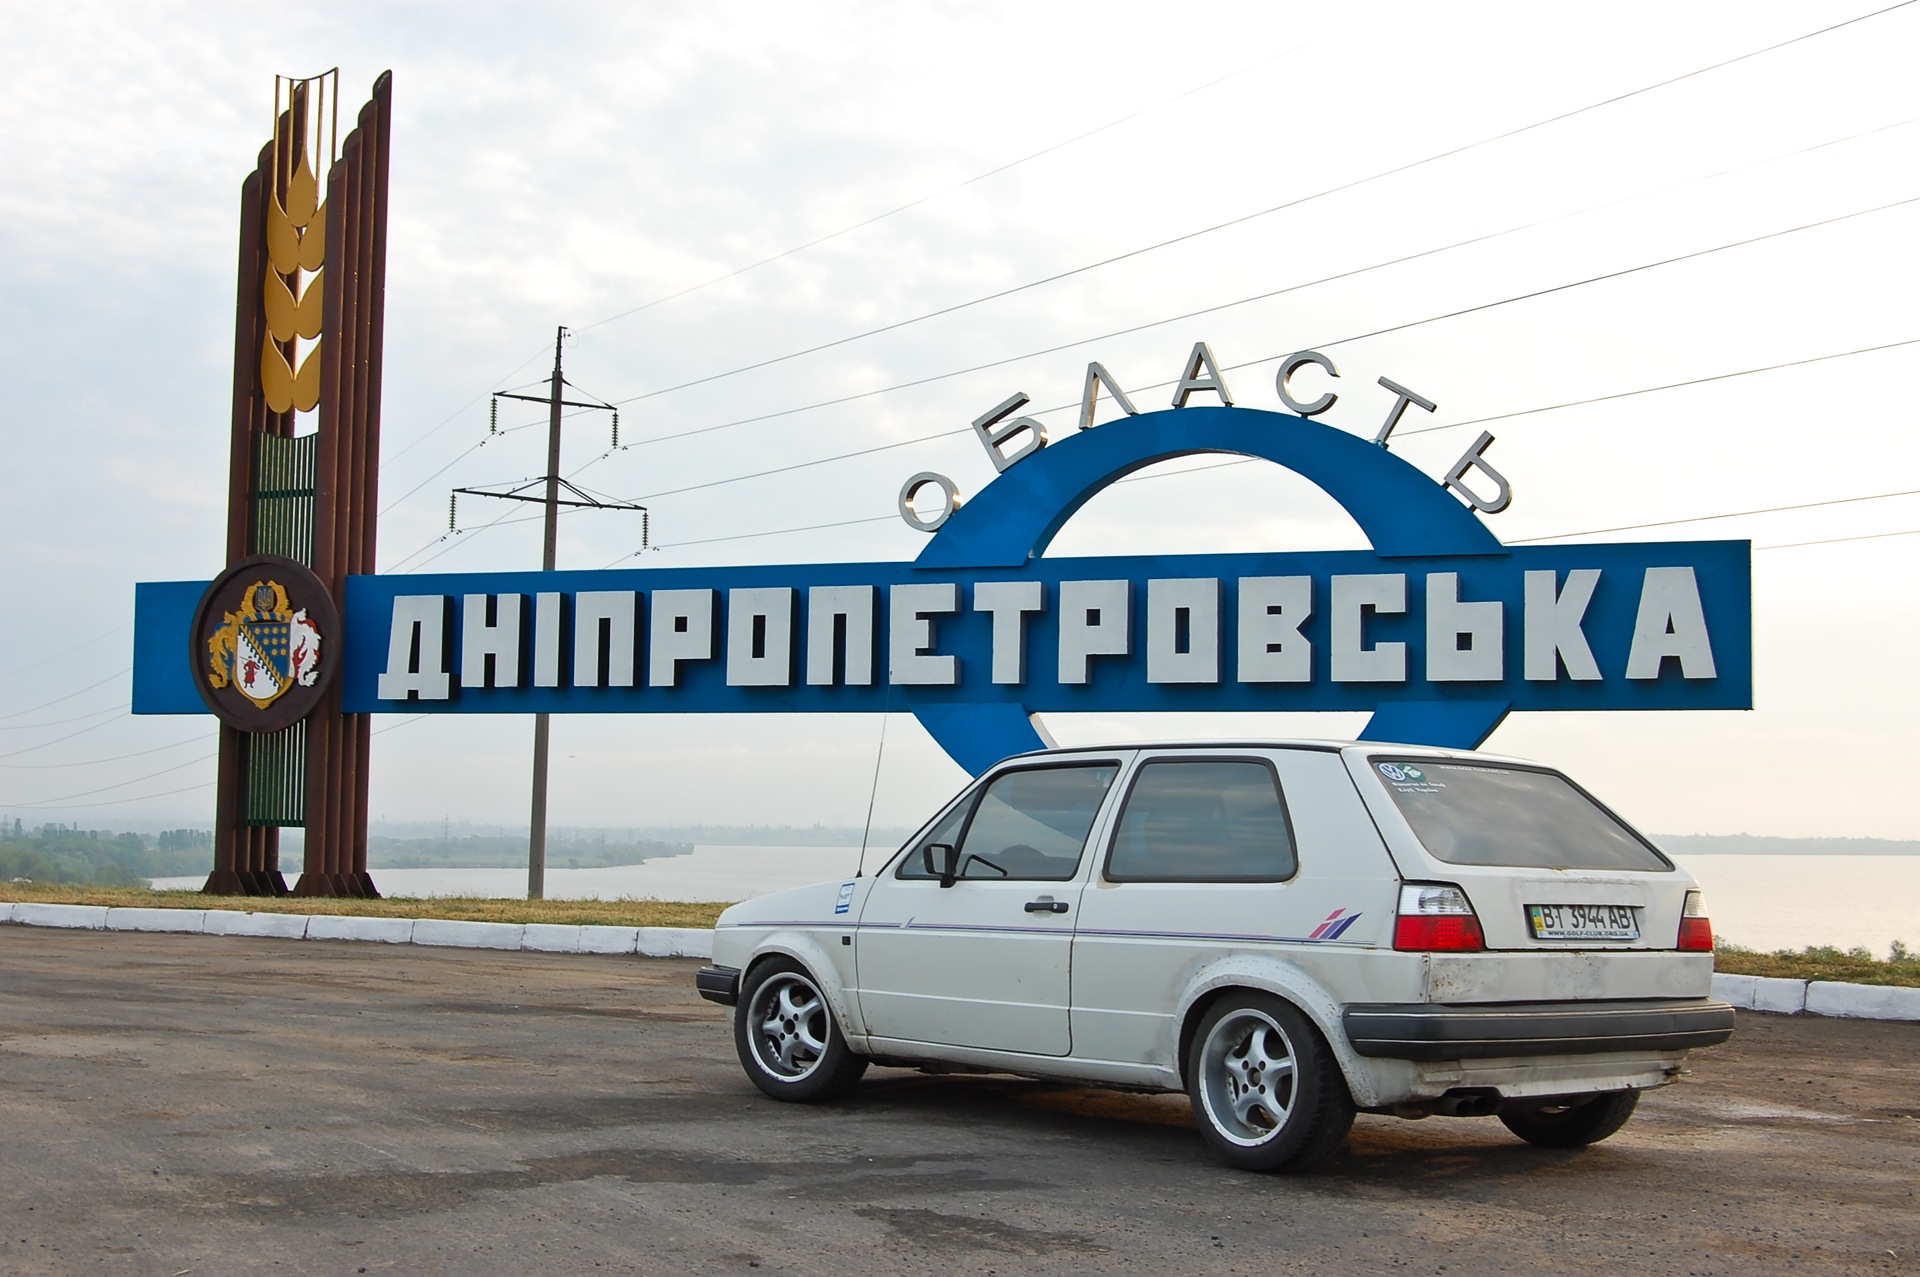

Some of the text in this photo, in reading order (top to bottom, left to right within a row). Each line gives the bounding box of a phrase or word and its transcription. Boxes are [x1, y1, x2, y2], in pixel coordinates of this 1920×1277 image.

[898, 342, 1513, 532] ОБЛАСТЬ
[378, 566, 1717, 700] ДНІПРОПЕТРОВСЬКА
[1568, 905, 1607, 929] 3944
